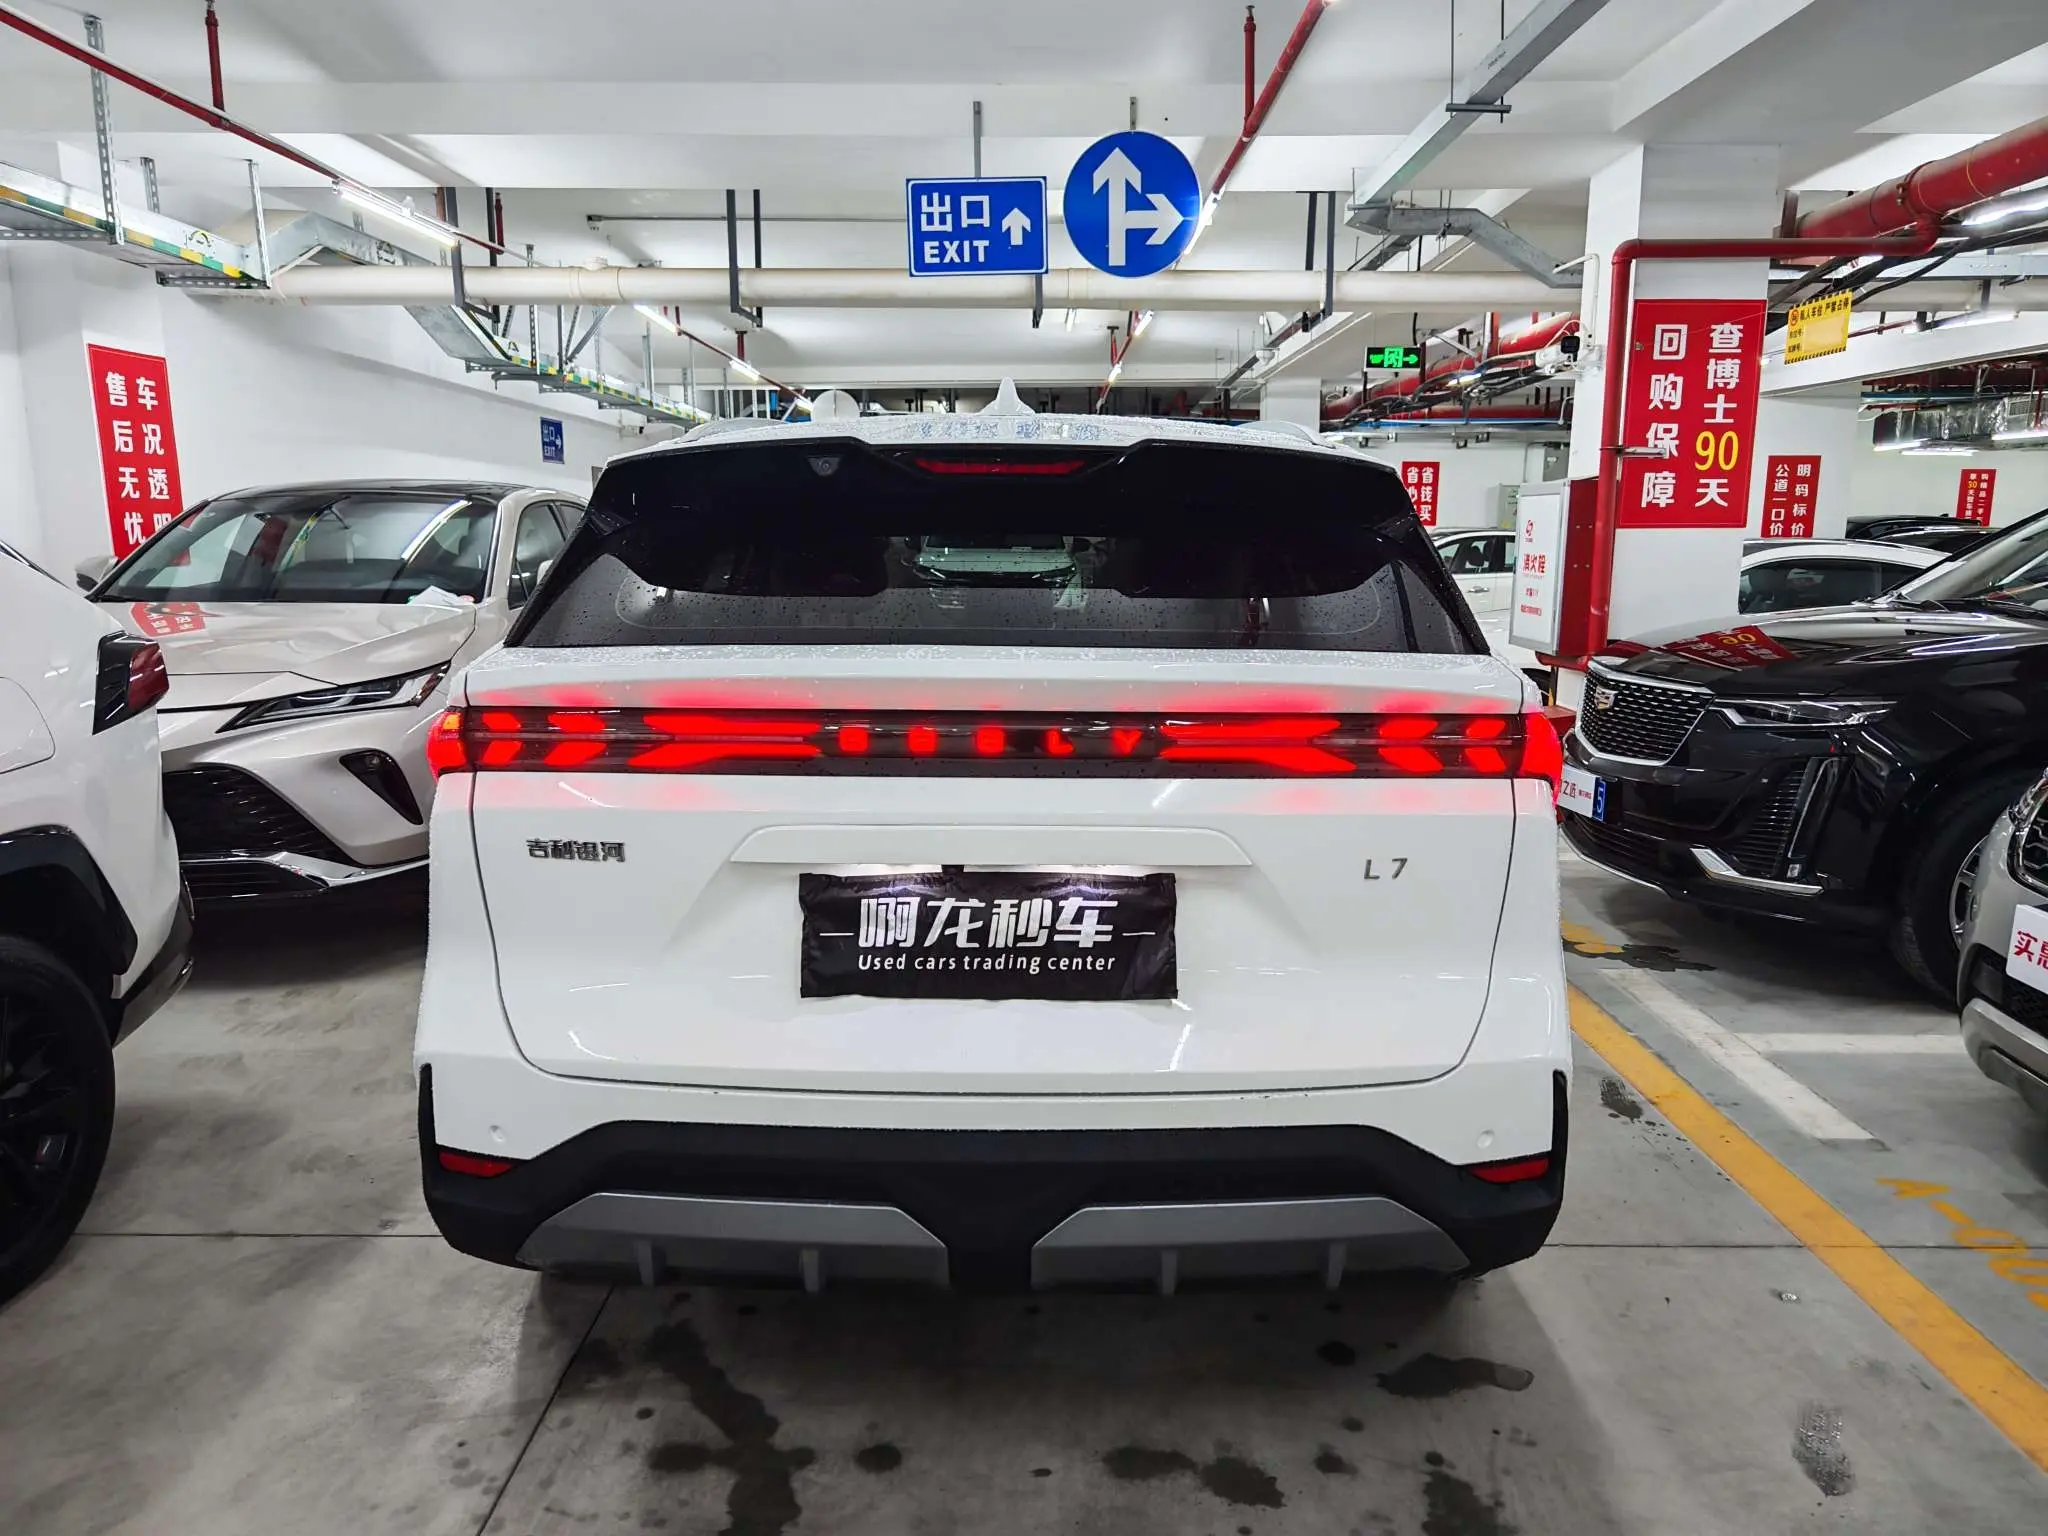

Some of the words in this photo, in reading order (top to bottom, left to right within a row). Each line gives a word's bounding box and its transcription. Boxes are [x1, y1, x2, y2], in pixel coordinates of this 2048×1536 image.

[920, 192, 990, 232] 出口
[923, 240, 989, 263] EXIT
[1641, 323, 1688, 508] 回购保障
[1694, 322, 1744, 507] 查博士90天
[106, 371, 146, 545] 售后无忧
[1769, 464, 1790, 536] 公道一口价
[1791, 464, 1812, 536] 明码标价
[858, 953, 906, 970] Used
[914, 957, 956, 970] cars
[963, 954, 1041, 974] trading
[1047, 956, 1116, 970] center
